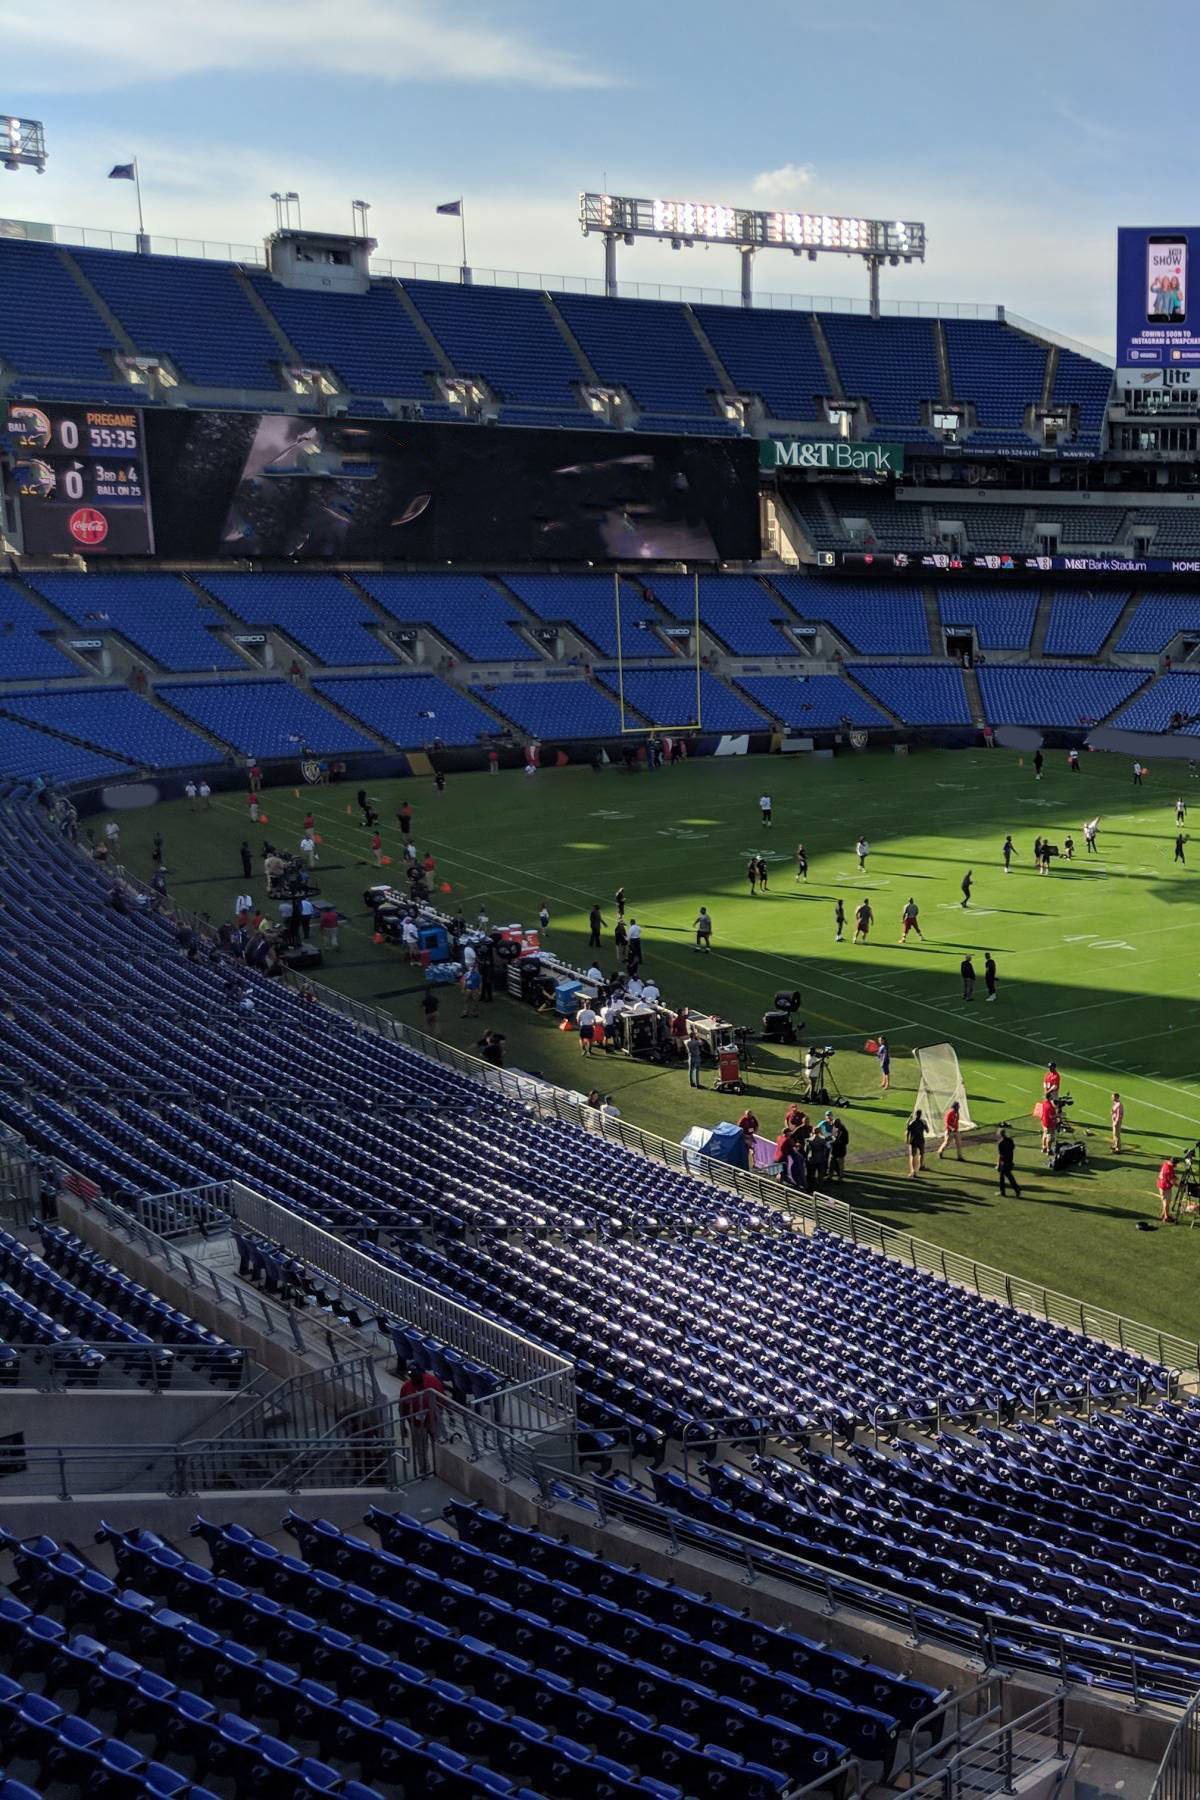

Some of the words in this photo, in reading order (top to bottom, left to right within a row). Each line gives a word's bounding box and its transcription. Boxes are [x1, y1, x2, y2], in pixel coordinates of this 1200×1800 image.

[1153, 255, 1181, 266] SHOW
[1162, 368, 1190, 387] Lite
[87, 413, 137, 427] PREGAME
[61, 421, 79, 449] 0
[91, 429, 136, 448] 55:35
[774, 441, 834, 467] M&T
[836, 444, 891, 469] Bank
[95, 465, 117, 481] 3RD
[118, 470, 126, 482] &
[128, 467, 138, 482] 4
[66, 471, 83, 499] 0
[96, 486, 116, 495] BALL
[118, 486, 129, 495] ON
[130, 487, 141, 496] 25
[1111, 560, 1146, 571] Stadium
[1173, 562, 1200, 572] HOME
